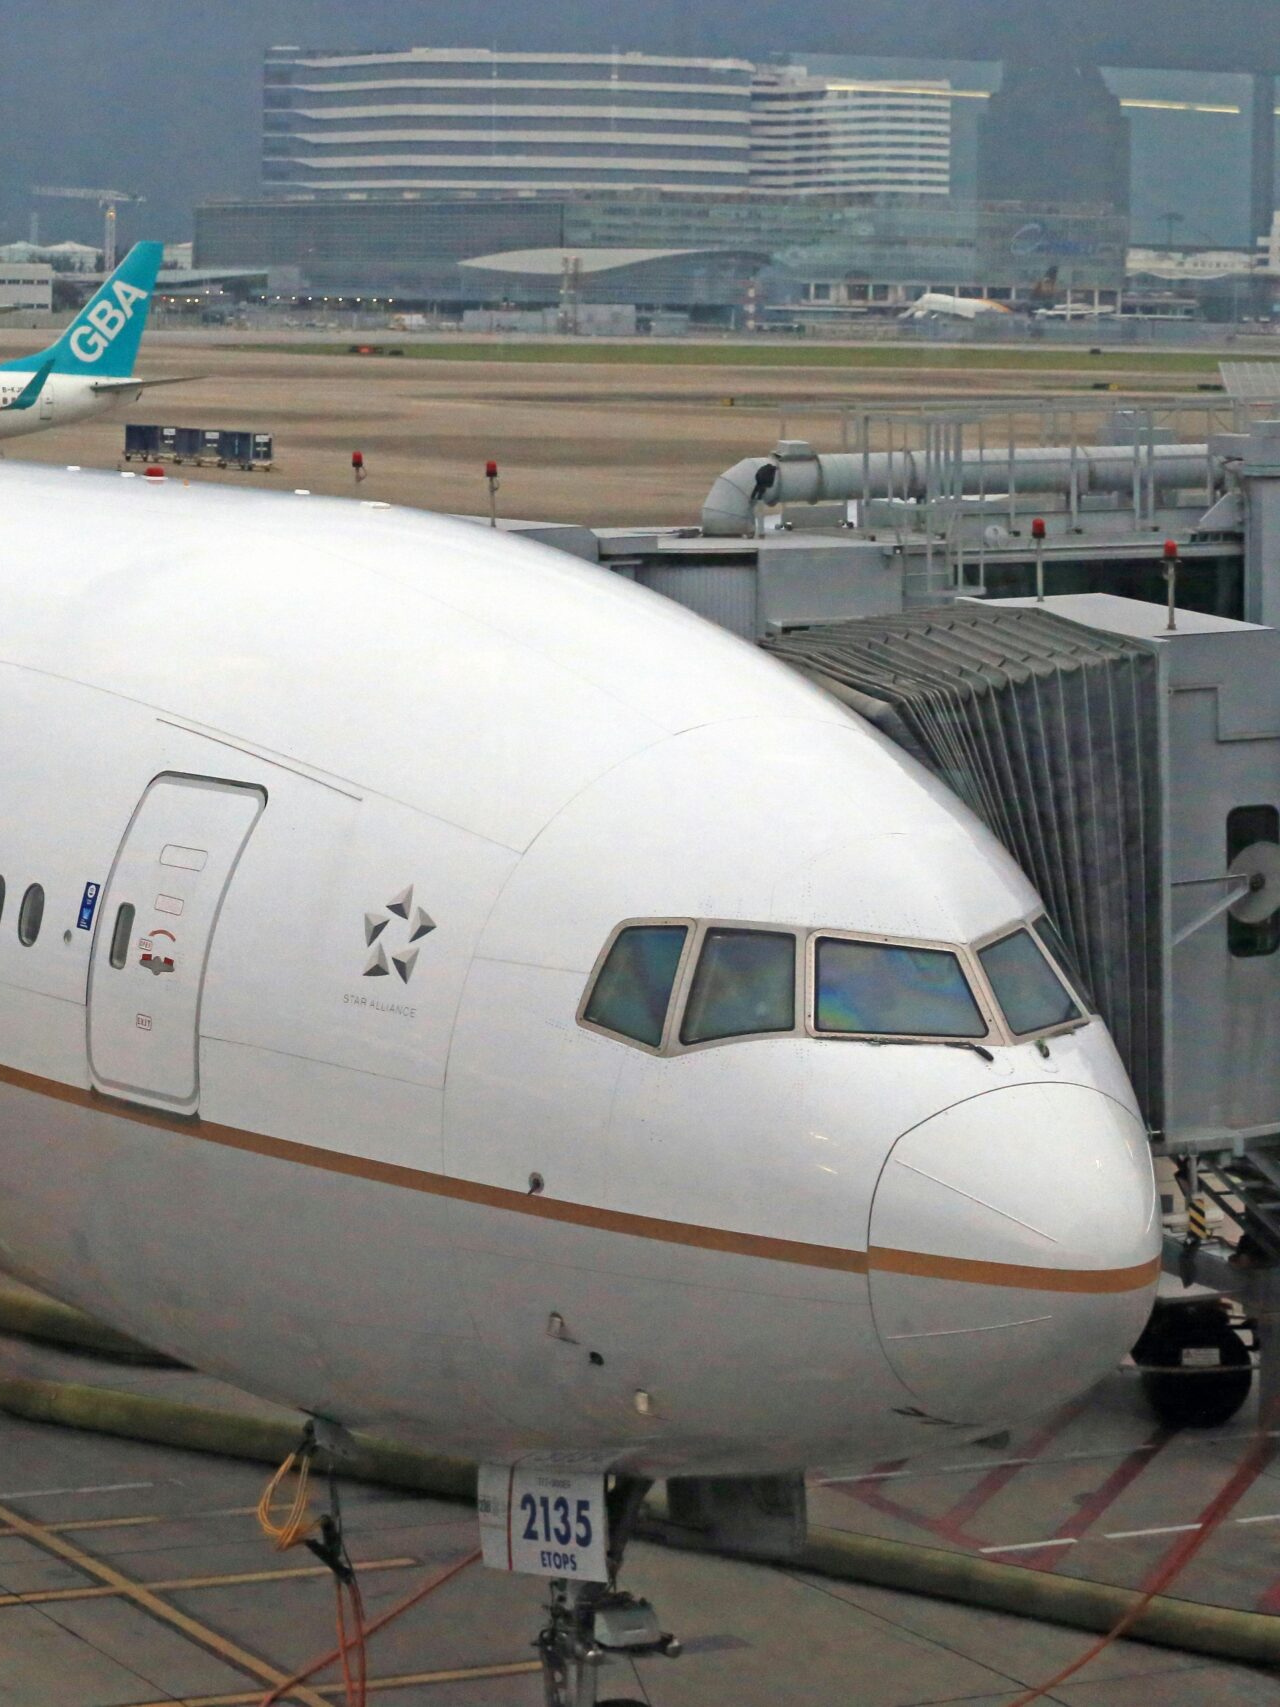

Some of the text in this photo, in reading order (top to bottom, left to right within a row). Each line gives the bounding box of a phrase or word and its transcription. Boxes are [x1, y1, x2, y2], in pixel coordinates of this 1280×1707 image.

[70, 280, 148, 362] GBA
[343, 993, 417, 1018] STAR ALLIANCE
[521, 1493, 592, 1547] 2135
[540, 1551, 577, 1571] ETOPS
